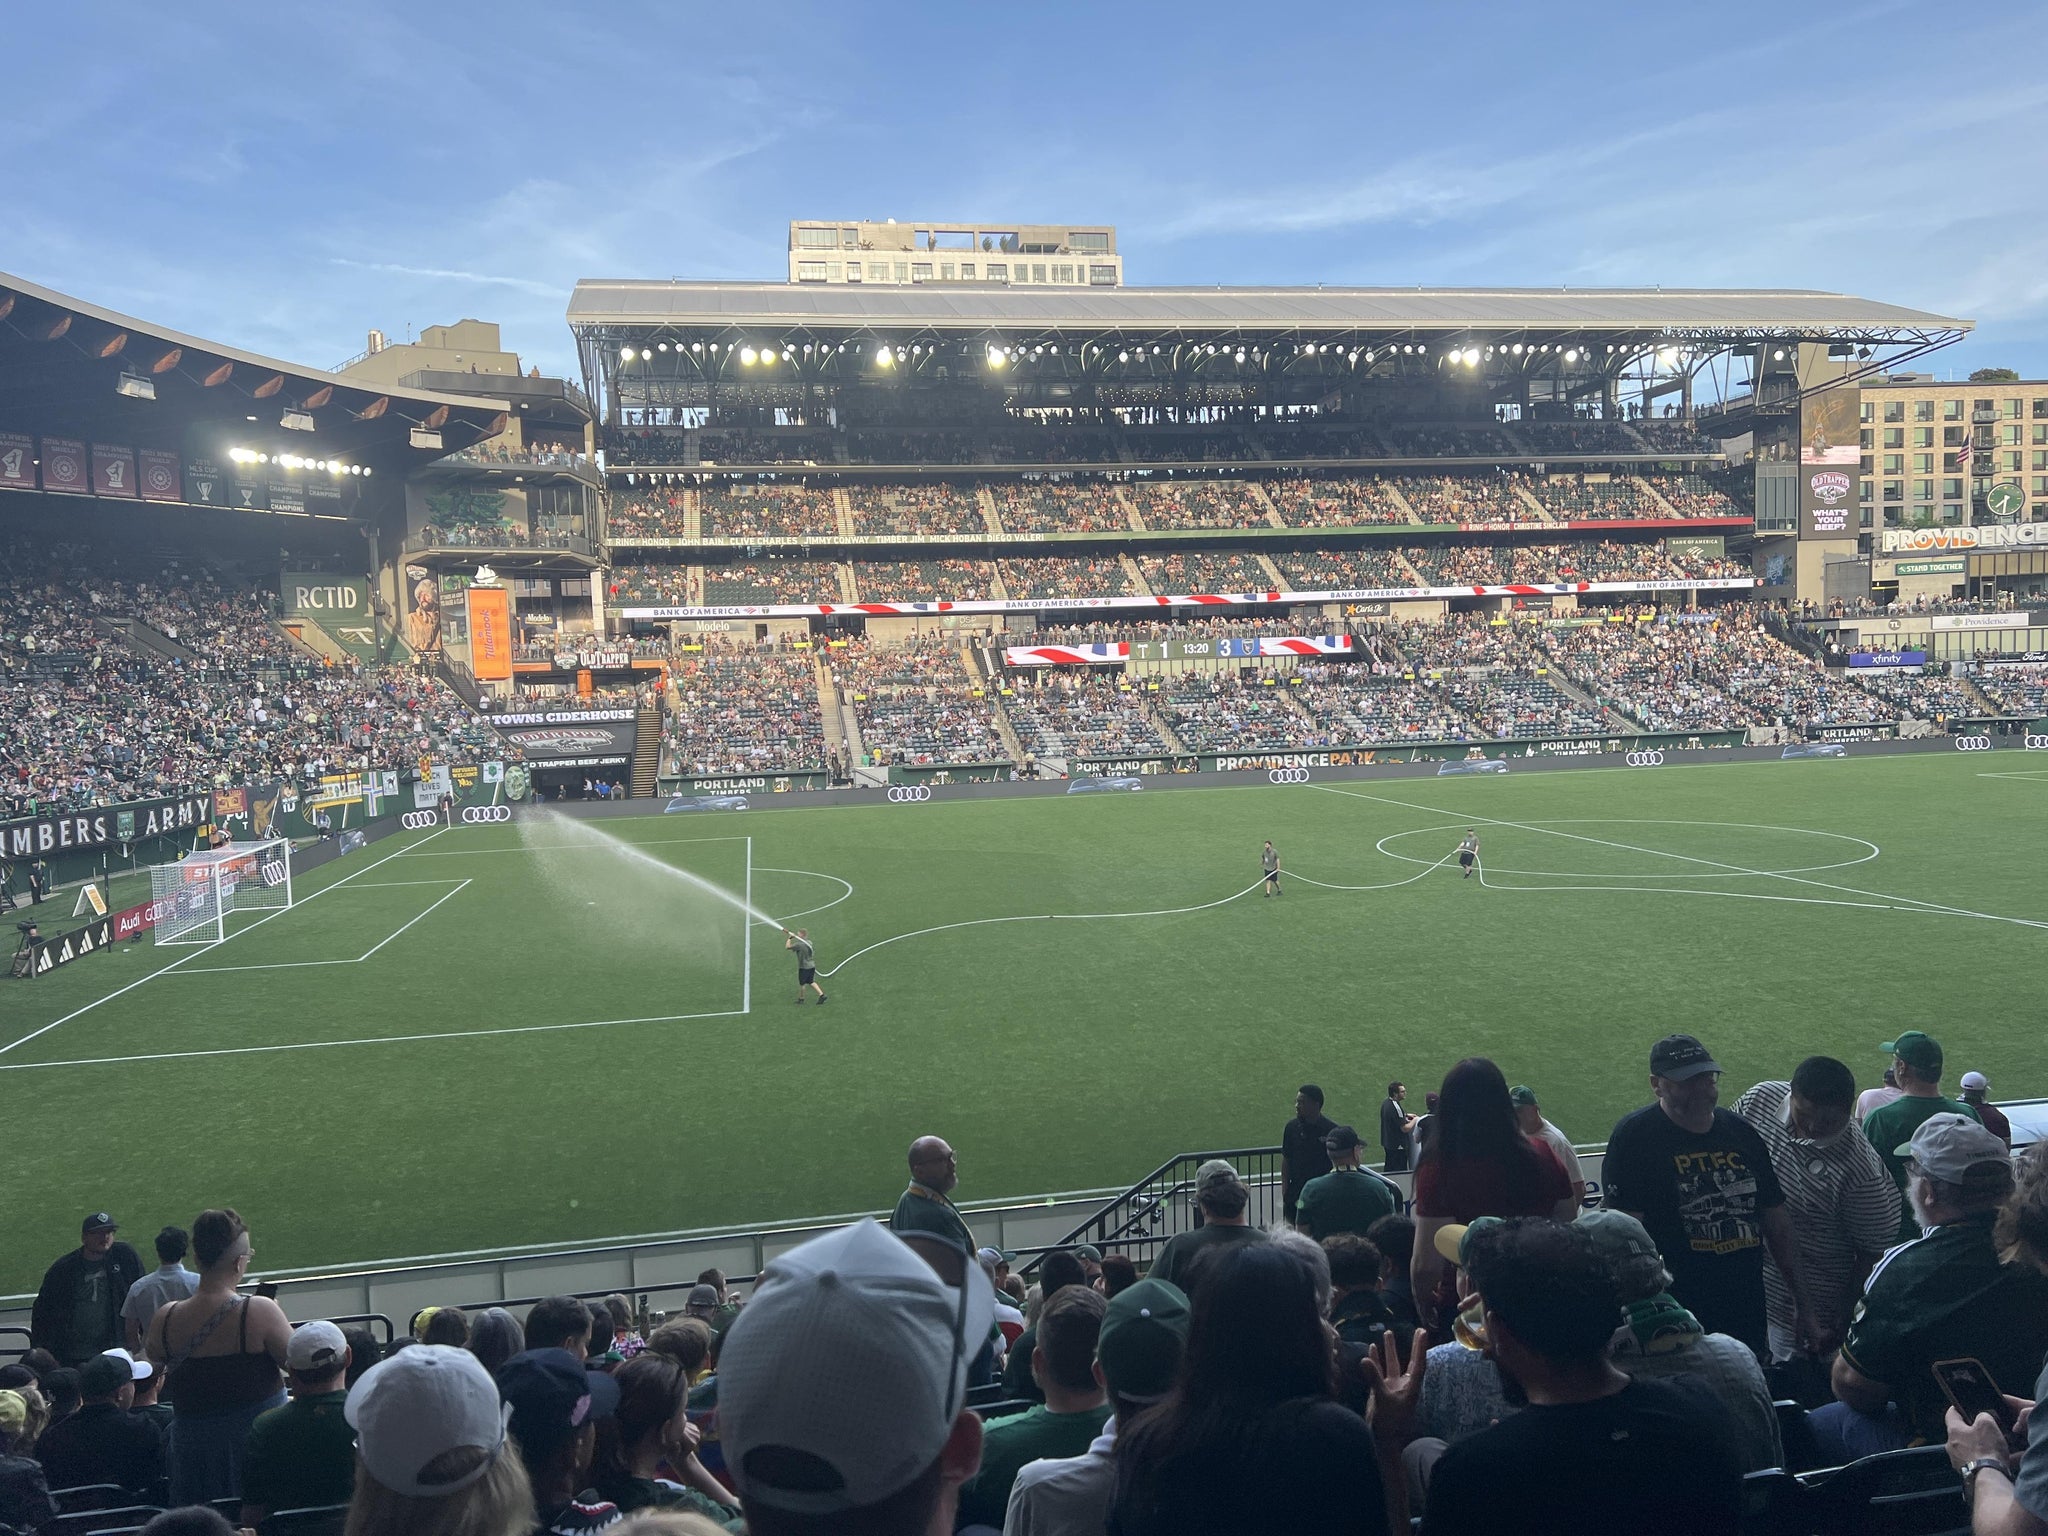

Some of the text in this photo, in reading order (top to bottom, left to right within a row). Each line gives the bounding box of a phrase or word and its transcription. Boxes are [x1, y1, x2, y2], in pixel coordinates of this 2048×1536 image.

[270, 486, 303, 494] CHAMPIONS
[308, 490, 341, 499] CHAMPIONS
[270, 504, 304, 512] CHAMPIONS
[1488, 523, 1510, 531] HONOR
[1514, 522, 1541, 530] CHRISTINE
[1543, 521, 1568, 530] SINCLAIR
[730, 537, 756, 545] CLIVE
[757, 536, 798, 545] CHARLES
[804, 536, 832, 544] JIMMY
[834, 536, 869, 544] CONWAY
[876, 536, 908, 544] TIMBER
[910, 535, 924, 543] JIM
[930, 534, 951, 543] MICK
[953, 534, 982, 542] HOBAN
[987, 534, 1012, 542] DIEGO
[1015, 533, 1044, 542] VALERI
[1883, 522, 2048, 552] PROVIDENCE
[1930, 563, 1964, 571] TOGETHER
[296, 586, 356, 609] RCTID
[1044, 600, 1084, 608] AMERICA
[1356, 604, 1374, 614] Carl's
[697, 608, 740, 616] AMERICA
[528, 614, 550, 622] Modelo
[696, 620, 730, 632] Modelo
[479, 608, 496, 660] Tillamook
[1160, 640, 1231, 658] 1 13:20 3
[580, 651, 594, 666] OLD
[594, 651, 629, 666] TRAPPER
[1872, 653, 1902, 664] xfinity
[2022, 652, 2047, 661] Ford
[522, 684, 556, 697] RAPPER
[492, 714, 544, 726] TOWNS
[546, 710, 634, 722] CIDERHOUSE
[512, 730, 610, 742] OLD TRAPPER
[1542, 740, 1600, 750] PORTLAND
[538, 760, 576, 768] TRAPPER
[1216, 753, 1329, 771] PROVIDENCE
[422, 782, 440, 791] LIVES
[694, 778, 765, 790] PORTLAND
[146, 798, 209, 834] ARMY
[120, 912, 140, 932] Audi
